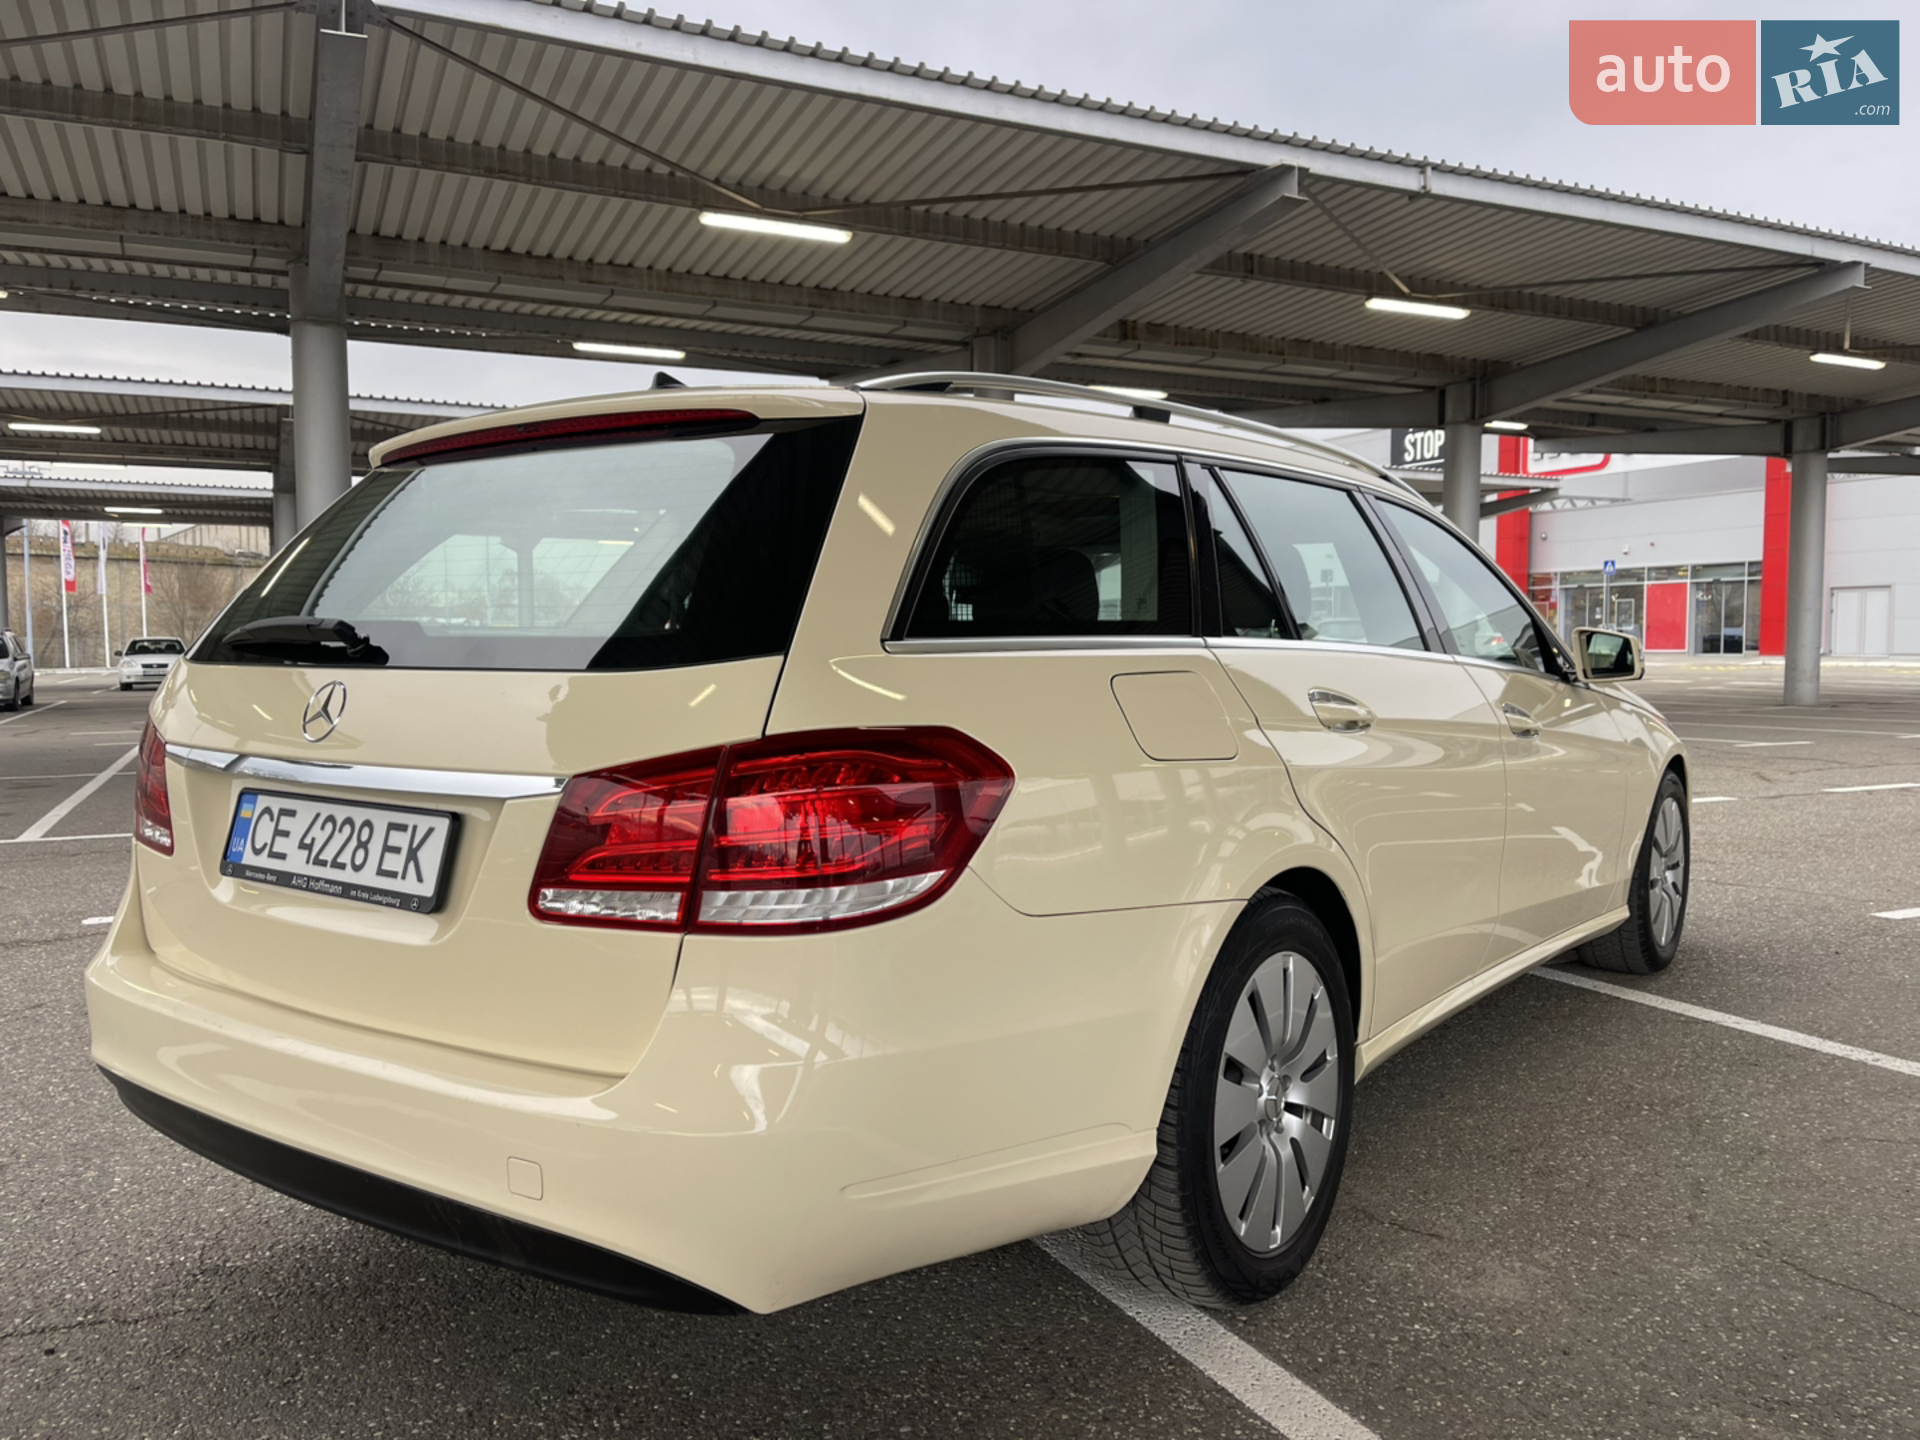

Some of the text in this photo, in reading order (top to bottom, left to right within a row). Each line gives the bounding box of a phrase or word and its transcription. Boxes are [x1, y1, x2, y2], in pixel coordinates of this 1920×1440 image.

[231, 836, 245, 852] UA
[250, 805, 436, 884] CE 4228 EK
[290, 875, 343, 894] AHG Hoffmann
